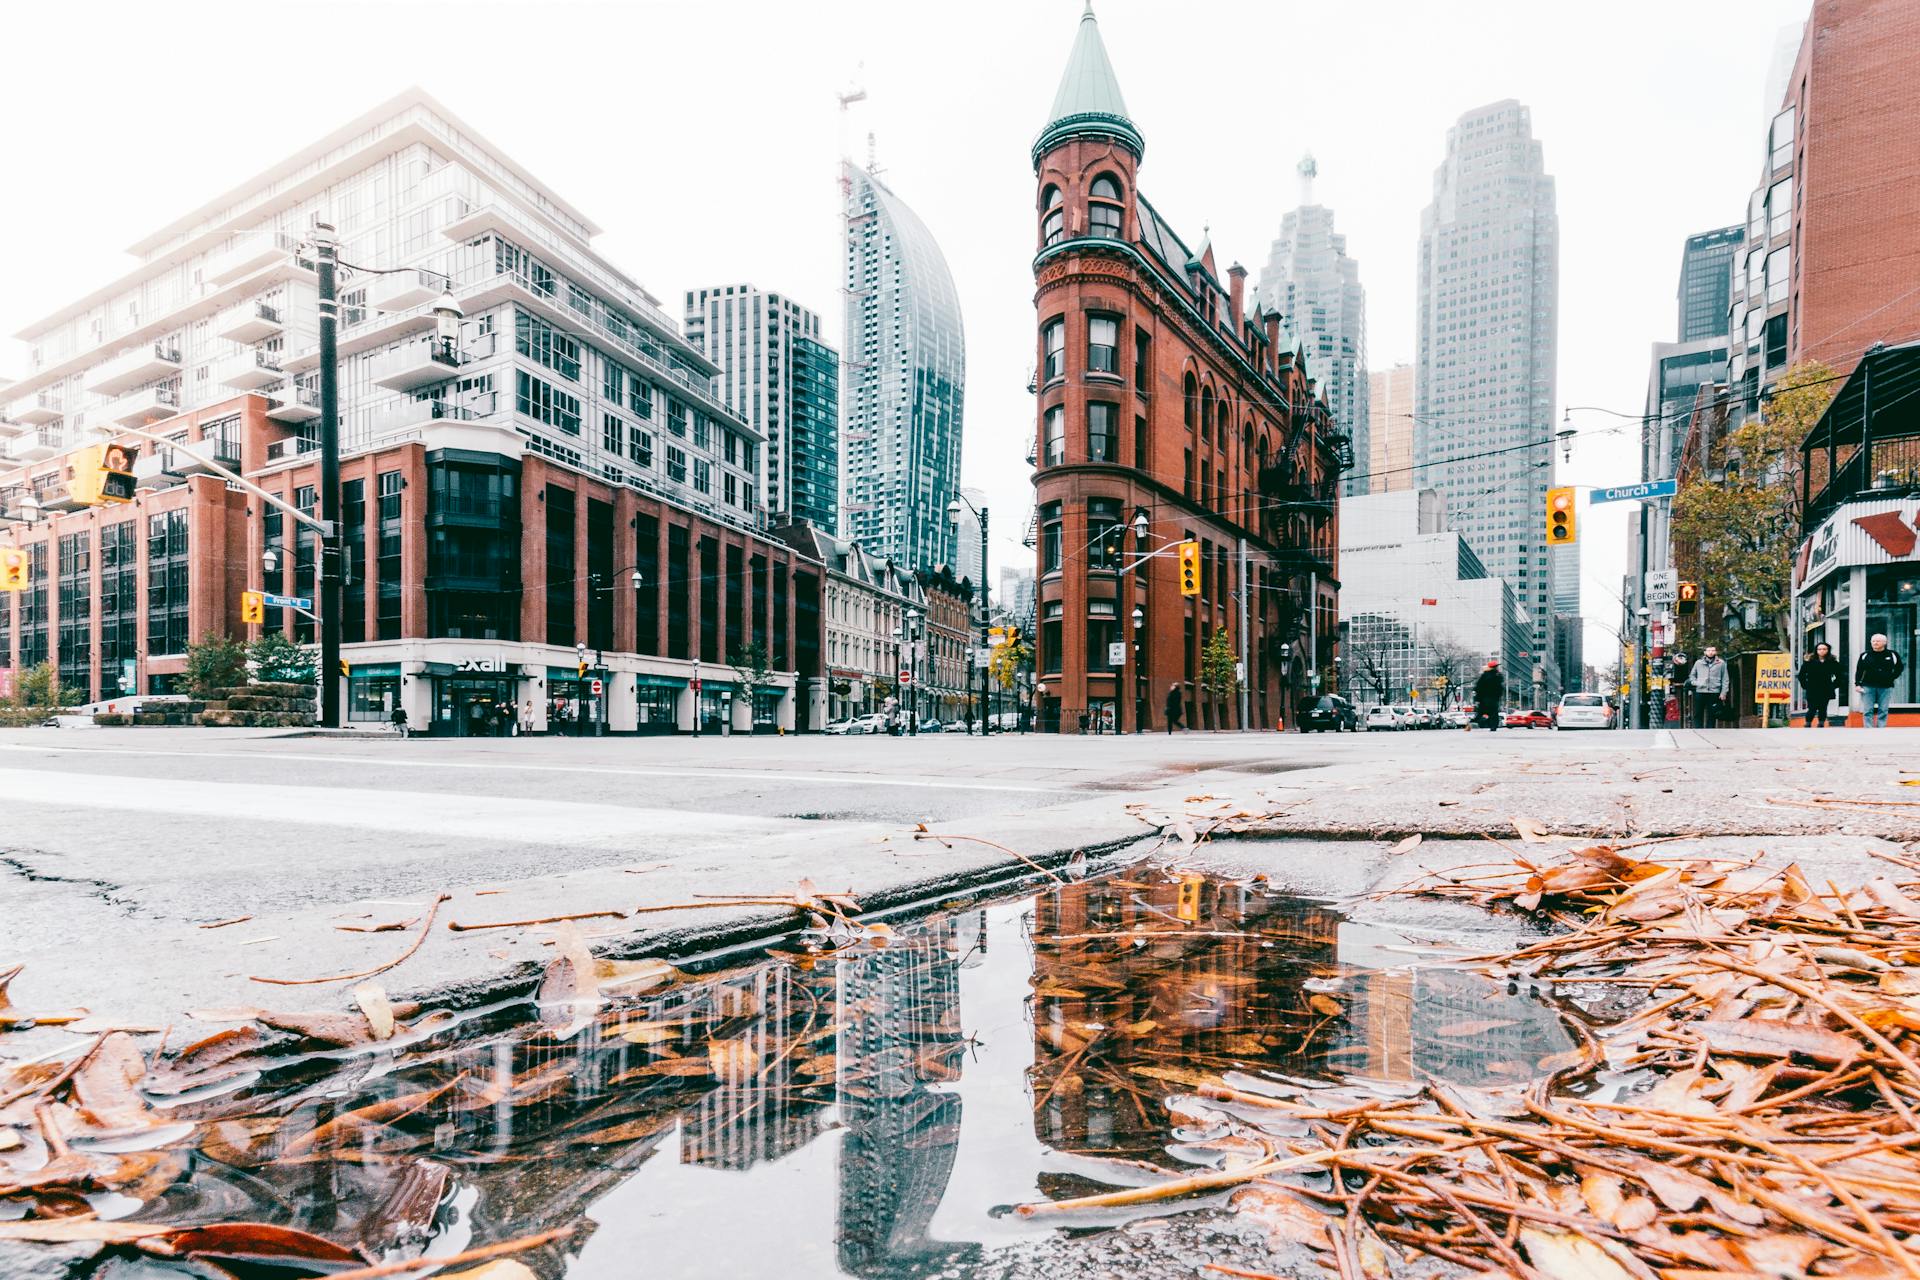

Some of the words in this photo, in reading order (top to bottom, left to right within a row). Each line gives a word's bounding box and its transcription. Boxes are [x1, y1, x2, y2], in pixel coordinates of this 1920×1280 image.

[1605, 484, 1648, 499] Church
[1653, 572, 1669, 581] ONE
[1653, 582, 1668, 590] WAY
[1647, 591, 1676, 600] BEGINS
[1760, 669, 1791, 678] PUBLIC
